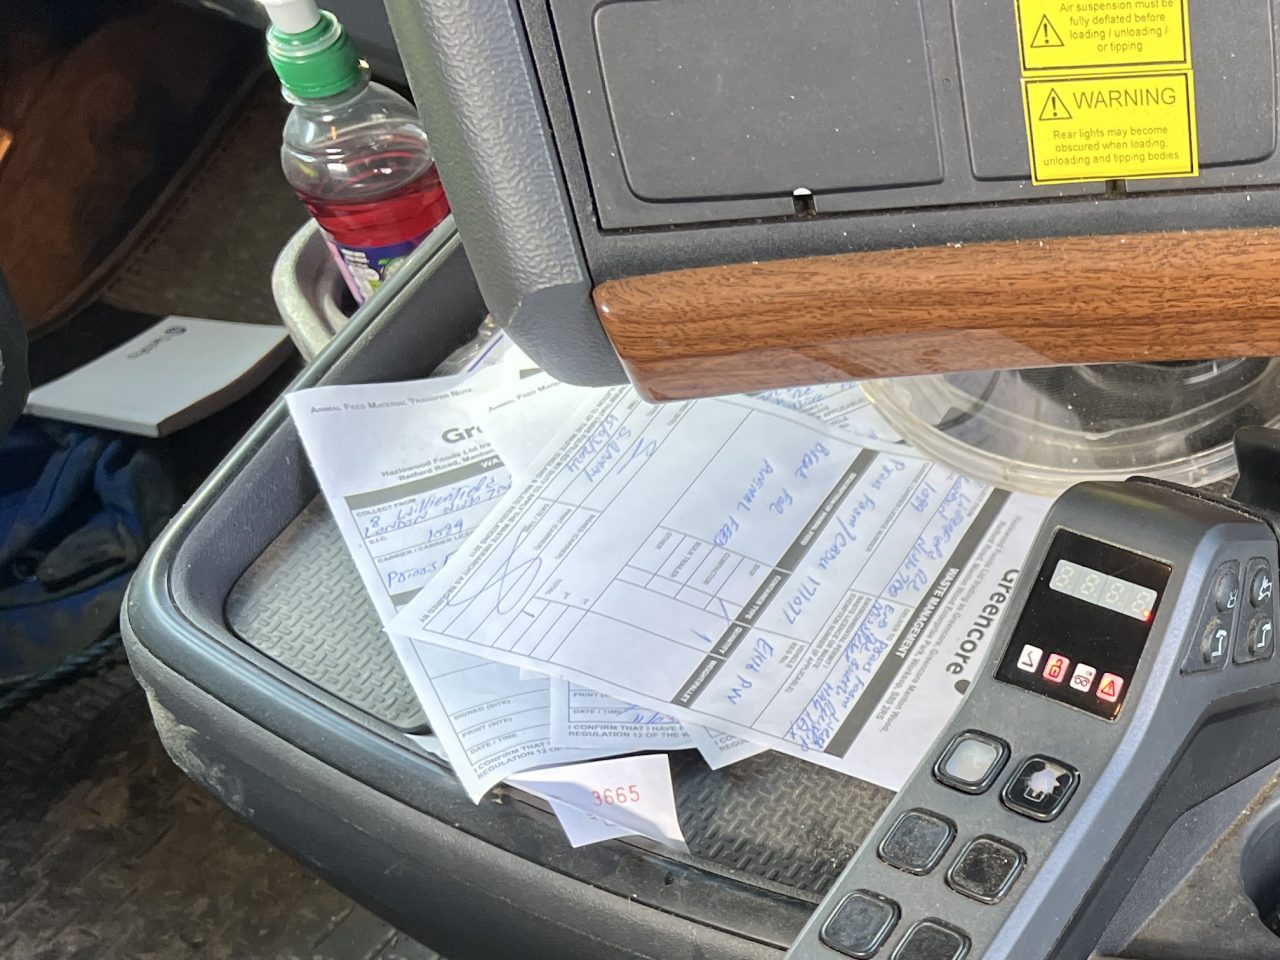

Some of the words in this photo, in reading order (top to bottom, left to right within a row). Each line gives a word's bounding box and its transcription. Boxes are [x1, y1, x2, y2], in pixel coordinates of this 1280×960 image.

[1060, 3, 1073, 12] Air
[1077, 1, 1132, 12] suspension
[1135, 0, 1160, 8] must
[1070, 16, 1089, 27] fully
[1092, 14, 1131, 25] deflated
[1134, 13, 1165, 23] before
[1070, 30, 1105, 41] loading
[1114, 27, 1162, 38] unloading
[1097, 44, 1107, 52] or
[1110, 41, 1143, 52] tipping
[1072, 87, 1176, 109] WARNING
[1053, 130, 1076, 140] Rear
[1079, 128, 1104, 139] lights
[1107, 128, 1127, 138] may
[1130, 125, 1168, 136] become
[1055, 142, 1099, 152] obscured
[1102, 140, 1127, 150] when
[1043, 155, 1090, 166] unloading
[1093, 153, 1110, 163] and
[1113, 151, 1145, 163] tipping
[1148, 151, 1179, 161] bodies
[930, 563, 960, 599] WASTE
[891, 594, 942, 659] MANAGEMENT
[568, 723, 631, 746] REGULATION
[645, 730, 658, 739] OF
[661, 729, 679, 739] THE
[572, 718, 620, 736] CONFIRM
[621, 721, 643, 733] THAT
[651, 722, 677, 734] HAVE
[474, 750, 537, 780] REGULATION
[591, 784, 640, 806] 3665
